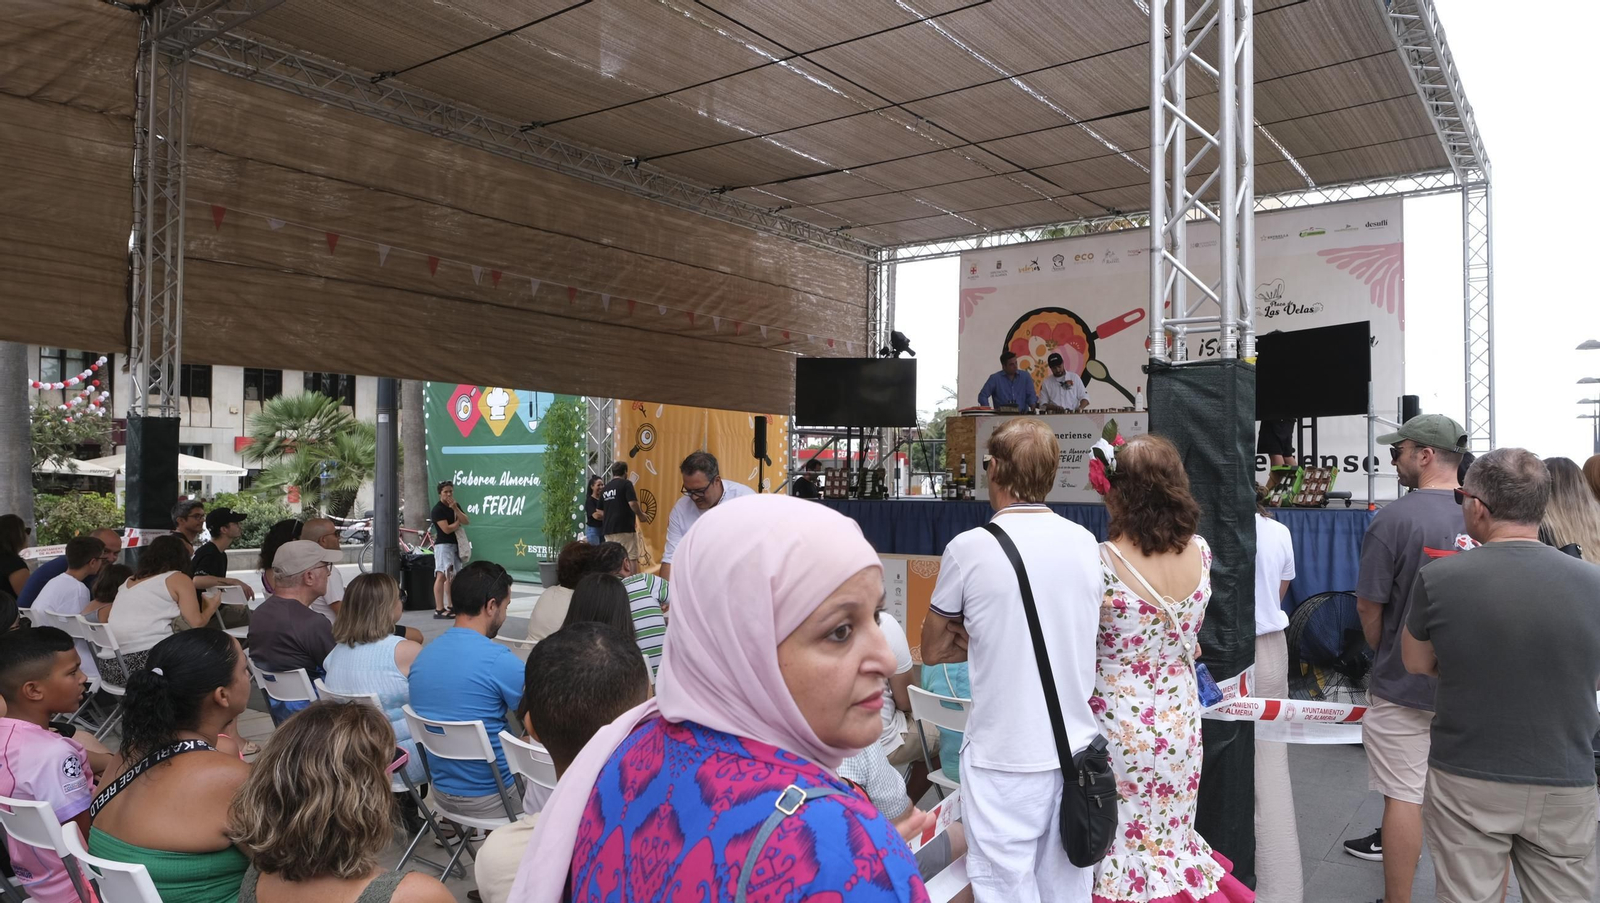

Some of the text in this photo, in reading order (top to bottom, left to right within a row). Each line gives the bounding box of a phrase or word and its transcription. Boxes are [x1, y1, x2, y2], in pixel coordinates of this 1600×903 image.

[1074, 252, 1094, 262] eco
[1265, 303, 1314, 318] Las Velas
[453, 470, 541, 487] ¡Saborea Almería
[467, 495, 526, 516] en FERIA!
[1230, 701, 1259, 710] AMIENTO
[1302, 706, 1345, 716] AYUNTAMIENTO
